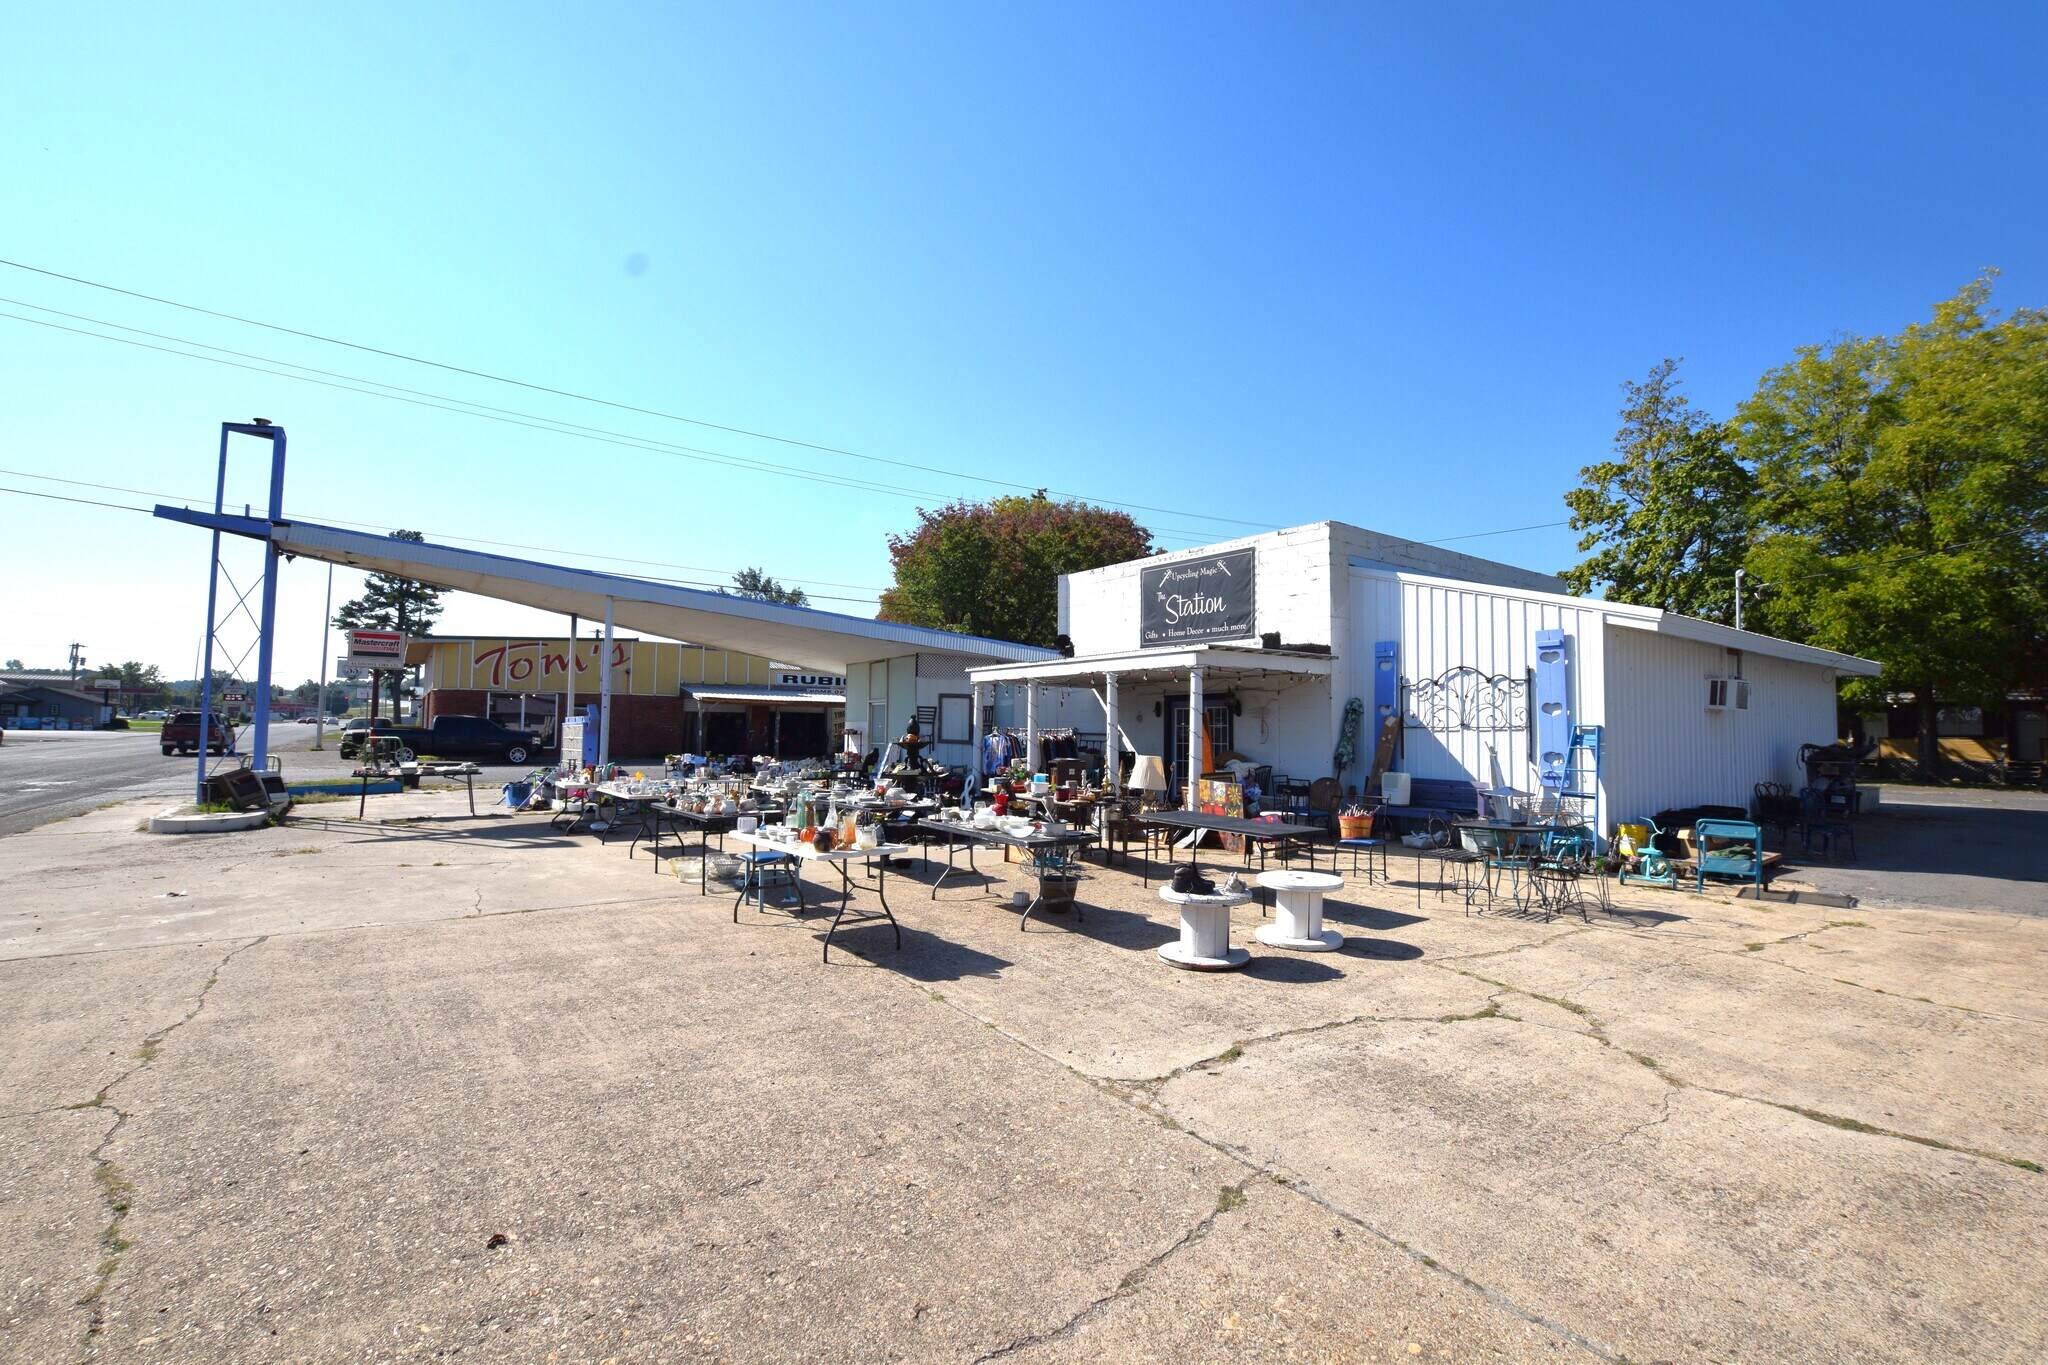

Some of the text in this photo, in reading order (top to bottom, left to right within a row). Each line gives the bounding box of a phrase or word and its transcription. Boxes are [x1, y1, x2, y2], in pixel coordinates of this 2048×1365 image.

[1200, 566, 1218, 577] Magic
[1165, 592, 1227, 624] Station
[1145, 622, 1247, 639] Gifts Home Decor much more
[354, 639, 400, 647] Mastercraft
[474, 643, 630, 686] Tom's
